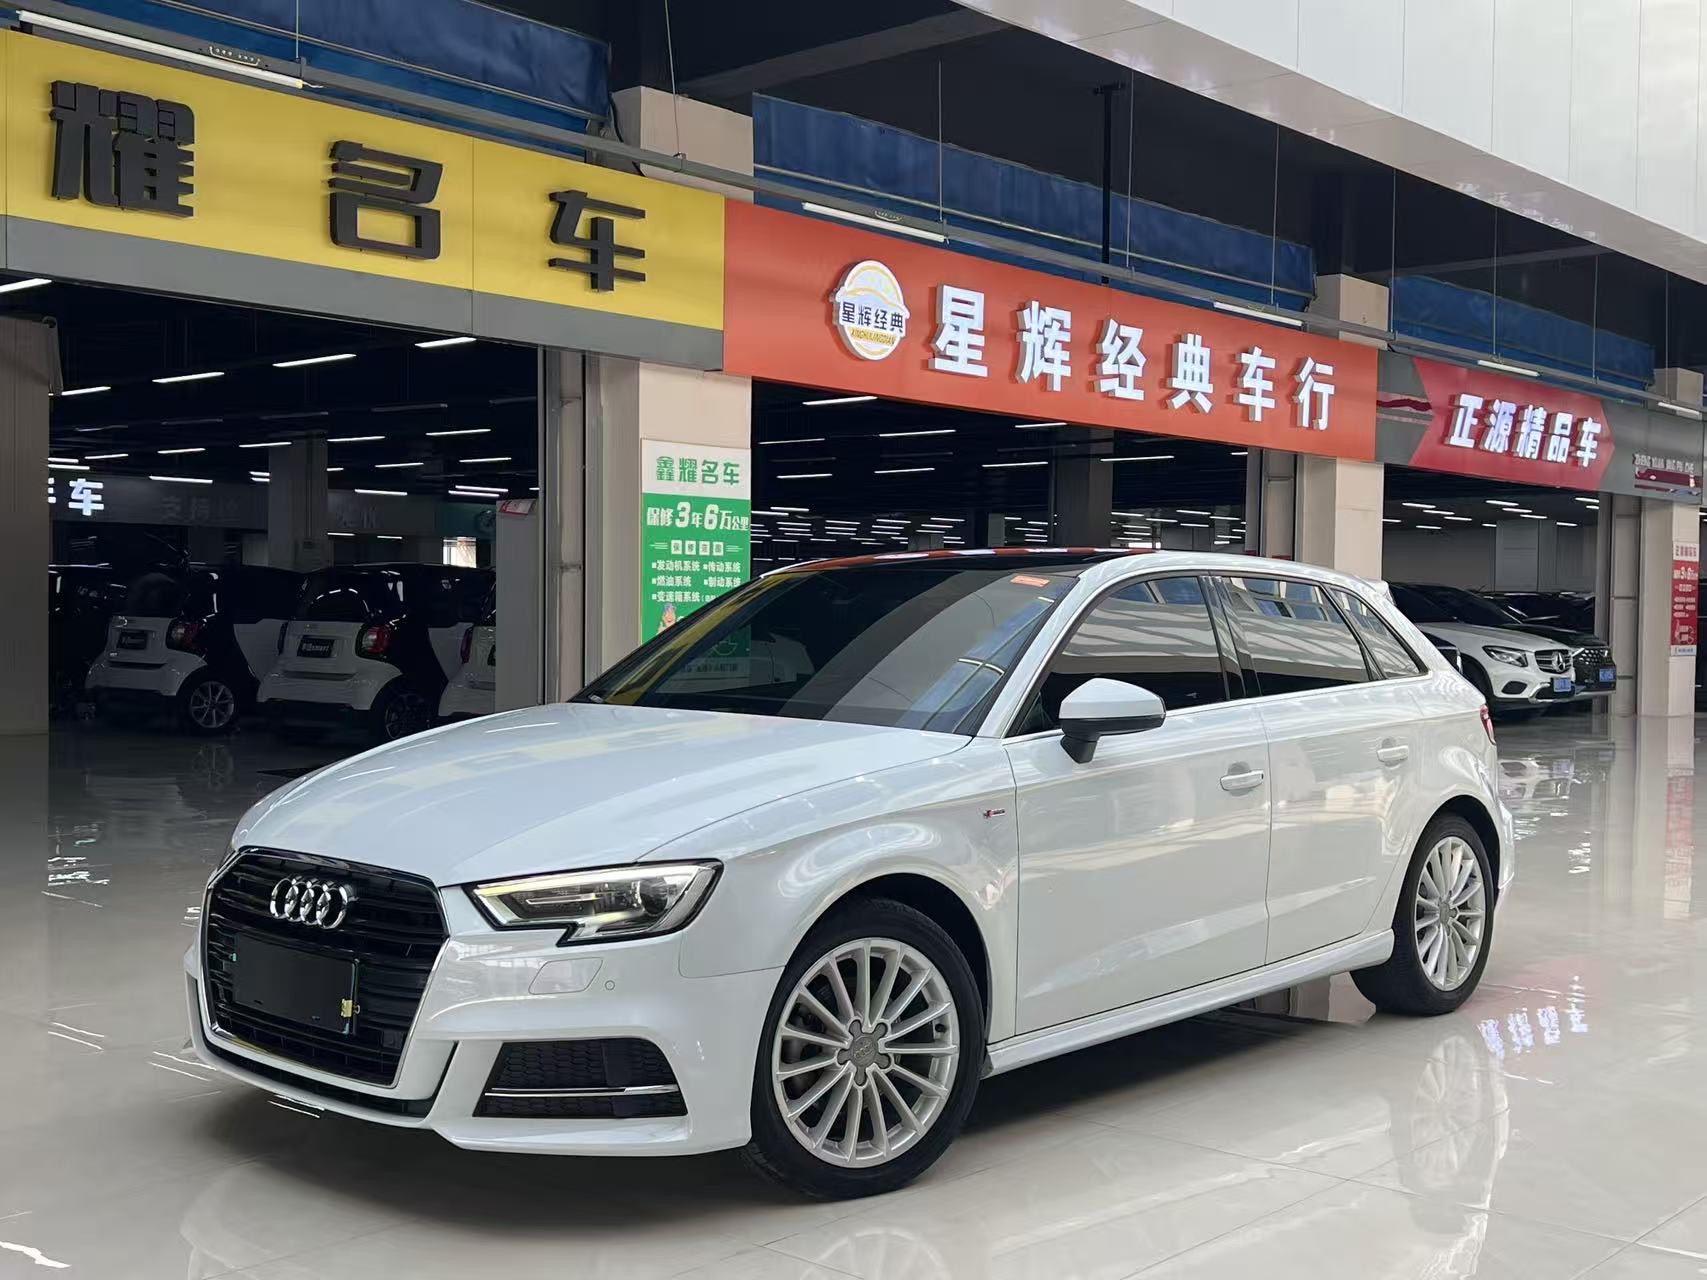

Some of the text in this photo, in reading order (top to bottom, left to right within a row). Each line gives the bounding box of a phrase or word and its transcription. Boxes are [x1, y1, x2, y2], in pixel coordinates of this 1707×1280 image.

[50, 80, 646, 292] 耀名车
[841, 301, 904, 333] 星辉经典
[929, 283, 1336, 431] 星辉经典车行
[1449, 393, 1602, 468] 正源精品车
[656, 455, 741, 486] 鑫耀名车
[656, 560, 741, 573] 发动机系统 传动系统
